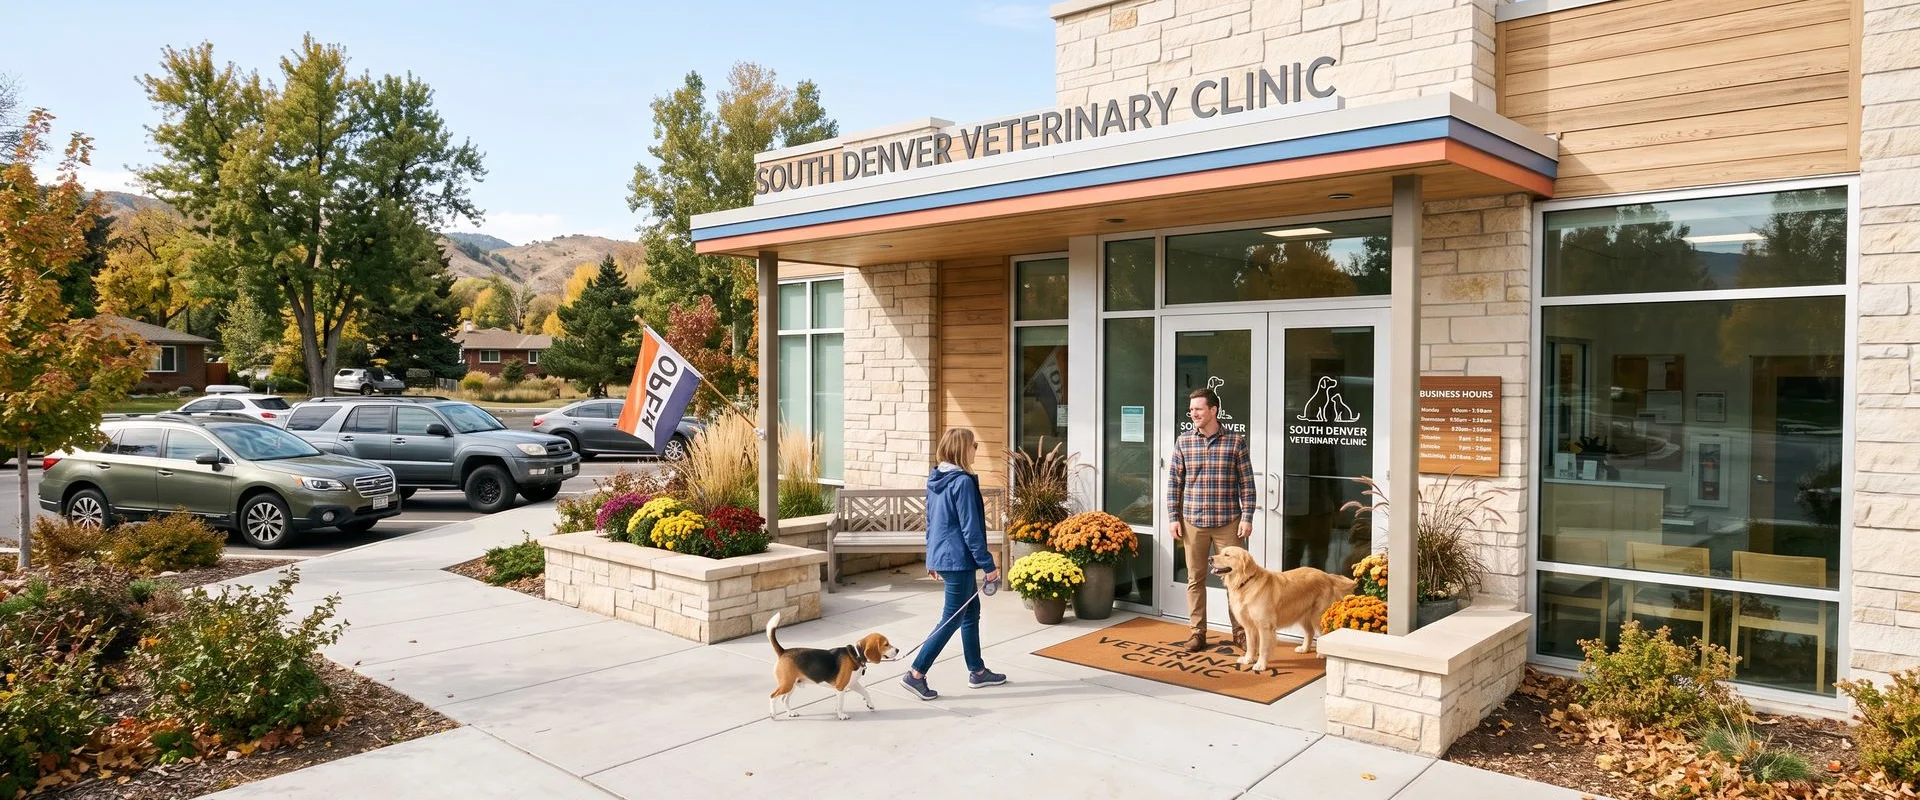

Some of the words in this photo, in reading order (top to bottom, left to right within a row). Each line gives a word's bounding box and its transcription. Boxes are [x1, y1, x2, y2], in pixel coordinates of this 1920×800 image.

[755, 154, 834, 195] SOUTH
[842, 132, 952, 181] DENVER
[960, 87, 1178, 160] VETERINARY
[1190, 56, 1337, 119] CLINIC
[1420, 390, 1460, 398] BUSINESS
[1462, 390, 1493, 398] HOURS
[1289, 425, 1324, 435] SOUTH
[1326, 426, 1368, 436] DENVER
[1289, 436, 1339, 445] VETERINARY
[1340, 437, 1368, 446] CLINIC
[1121, 652, 1230, 679] CLINIC
